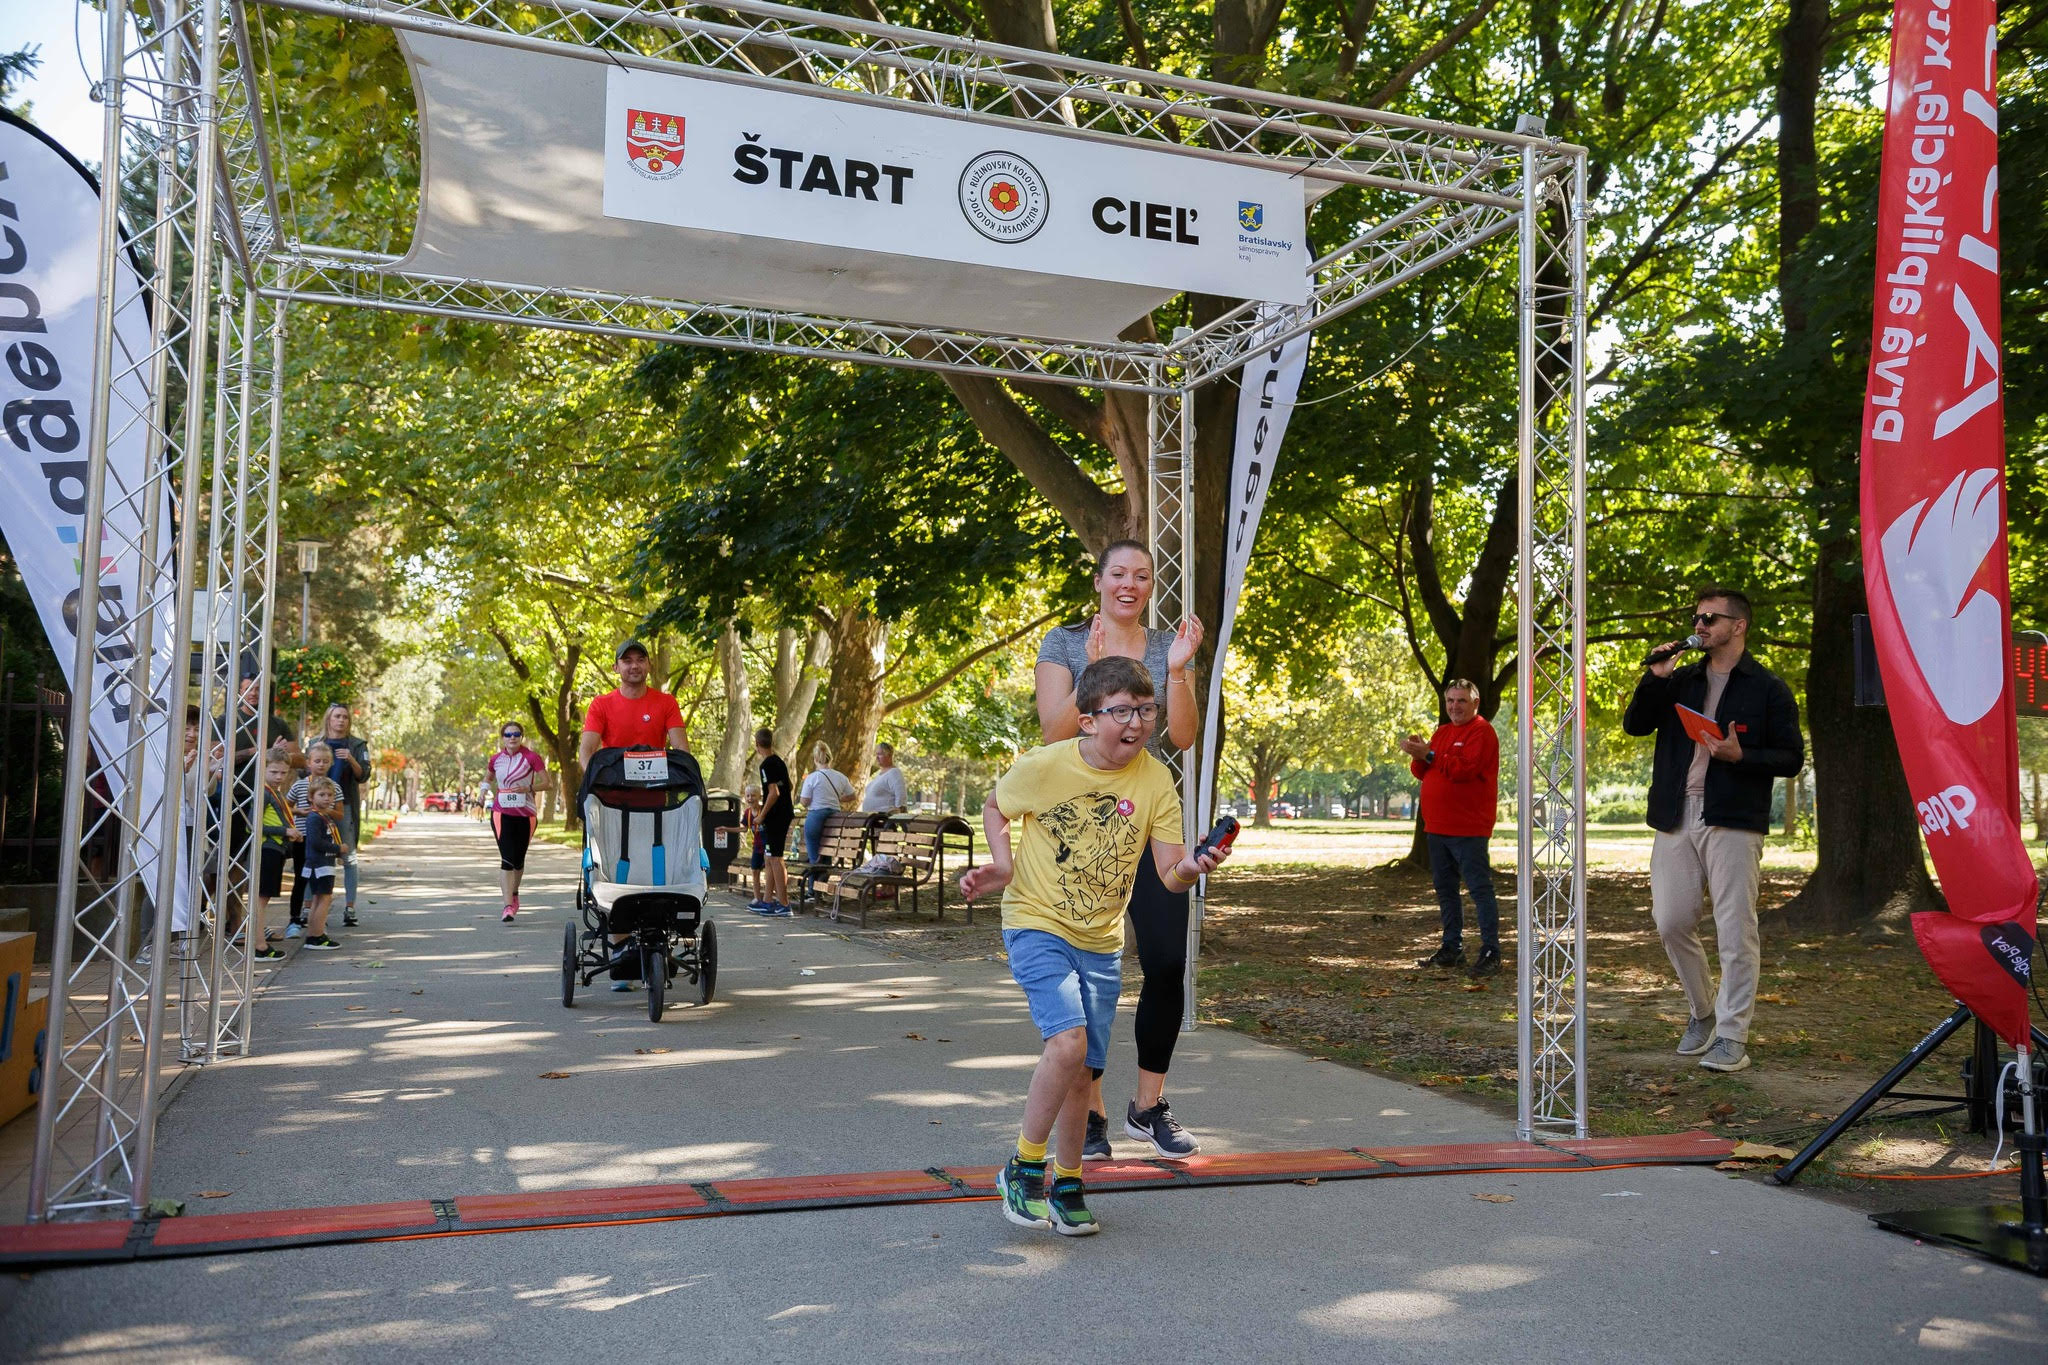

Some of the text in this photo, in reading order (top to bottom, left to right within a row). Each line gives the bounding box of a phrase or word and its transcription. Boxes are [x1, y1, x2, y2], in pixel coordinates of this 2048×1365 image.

[732, 131, 914, 206] ŠTART
[970, 160, 1041, 197] RUŽINOVSKÝ KOLOTOČ
[967, 198, 1039, 235] RUŽINOVSKÝ KOLOTOČ
[1091, 196, 1199, 246] CIEĽ
[1238, 234, 1293, 251] Bratislavský
[1238, 245, 1280, 258] samosprávny
[1238, 254, 1252, 263] kraj
[638, 760, 653, 771] 37
